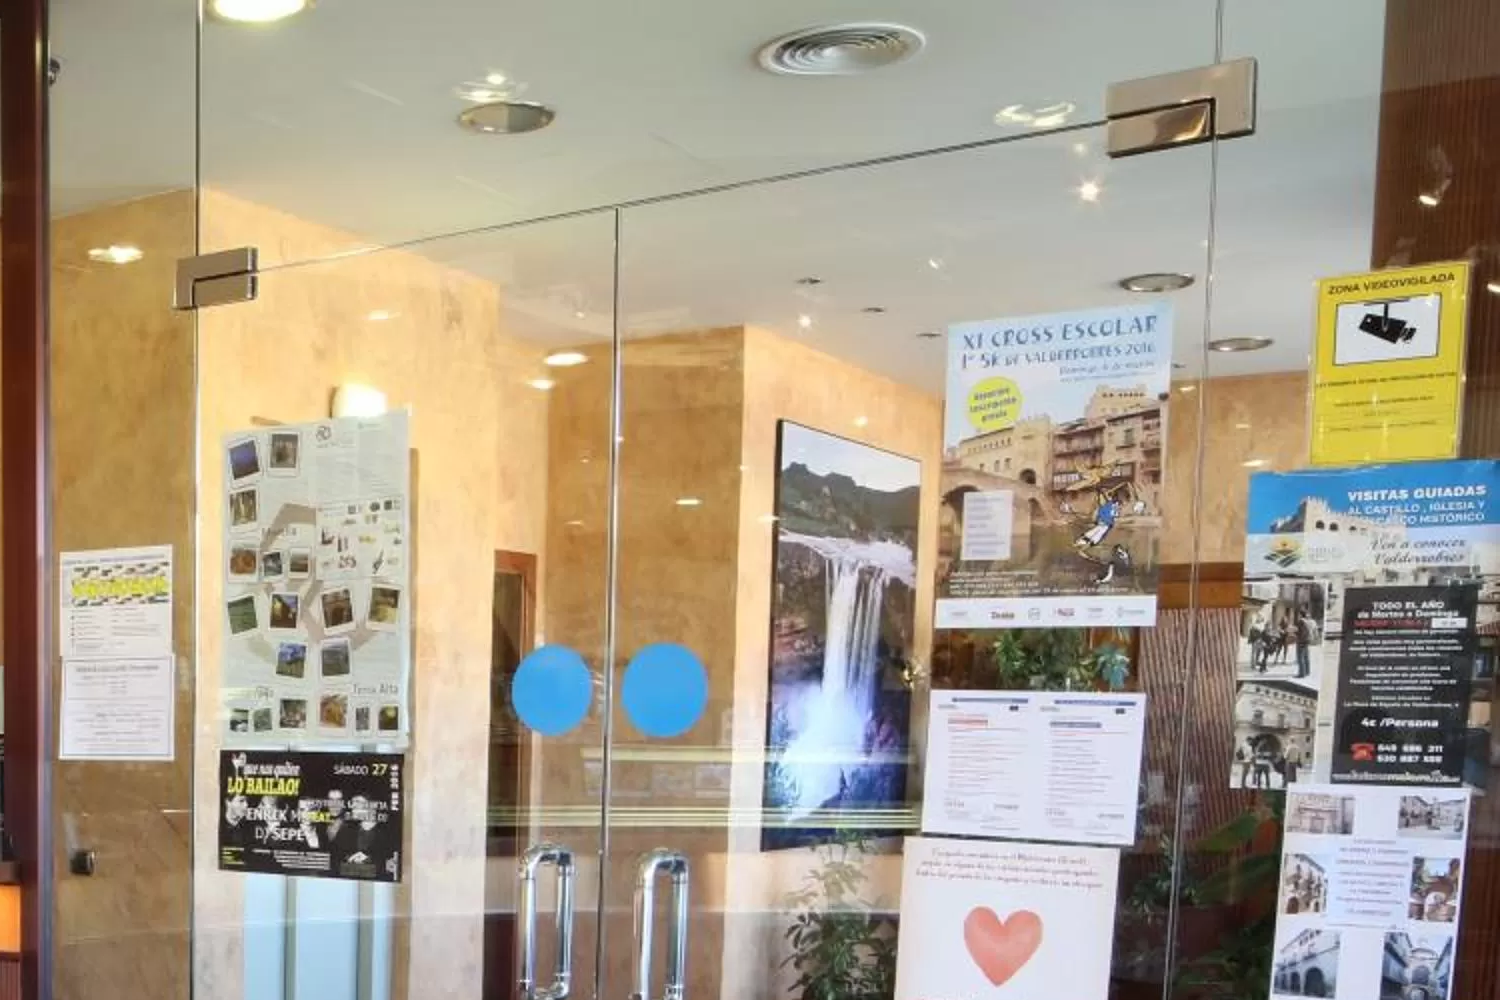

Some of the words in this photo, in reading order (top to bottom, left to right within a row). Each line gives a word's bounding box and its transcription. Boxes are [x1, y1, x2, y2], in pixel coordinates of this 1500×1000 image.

[1328, 280, 1360, 295] ZONA
[1363, 272, 1455, 292] VIDEOVIGILADA
[963, 332, 983, 350] XI
[992, 325, 1053, 347] CROSS
[1062, 316, 1158, 341] ESCOLAR
[1347, 489, 1409, 502] VISITAS
[1413, 484, 1487, 499] GUIADAS
[1429, 501, 1477, 511] IGLESIA
[1372, 601, 1402, 610] TODO
[372, 763, 388, 776] 27
[227, 777, 244, 794] LO
